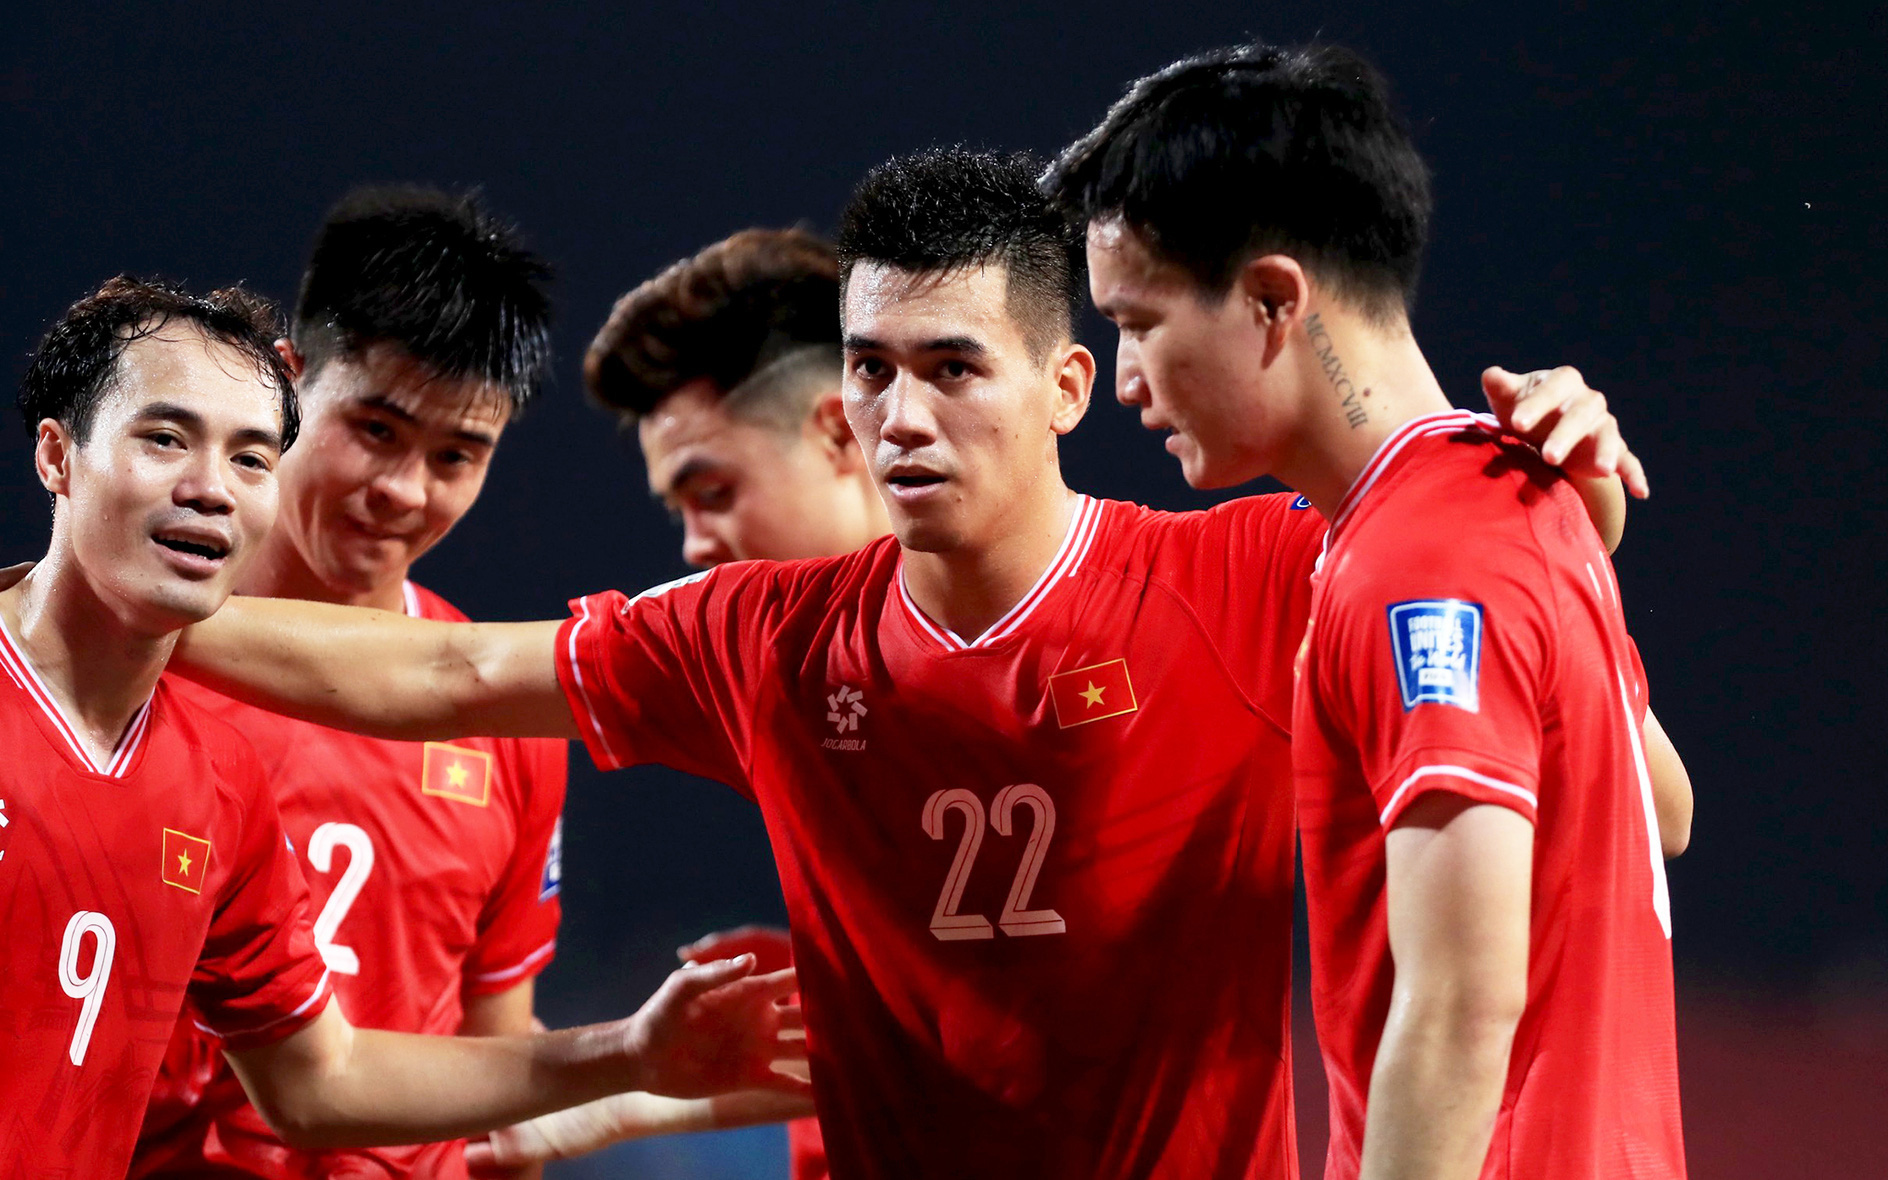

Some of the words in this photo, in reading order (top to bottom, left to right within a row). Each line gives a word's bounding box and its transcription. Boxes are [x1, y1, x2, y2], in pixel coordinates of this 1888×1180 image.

[1304, 313, 1368, 430] MCMXCVIII
[1408, 615, 1463, 632] FOOTBL
[821, 738, 867, 751] JOCARBOLA
[307, 822, 375, 975] 2
[922, 783, 1067, 941] 22
[58, 910, 116, 1066] 9
